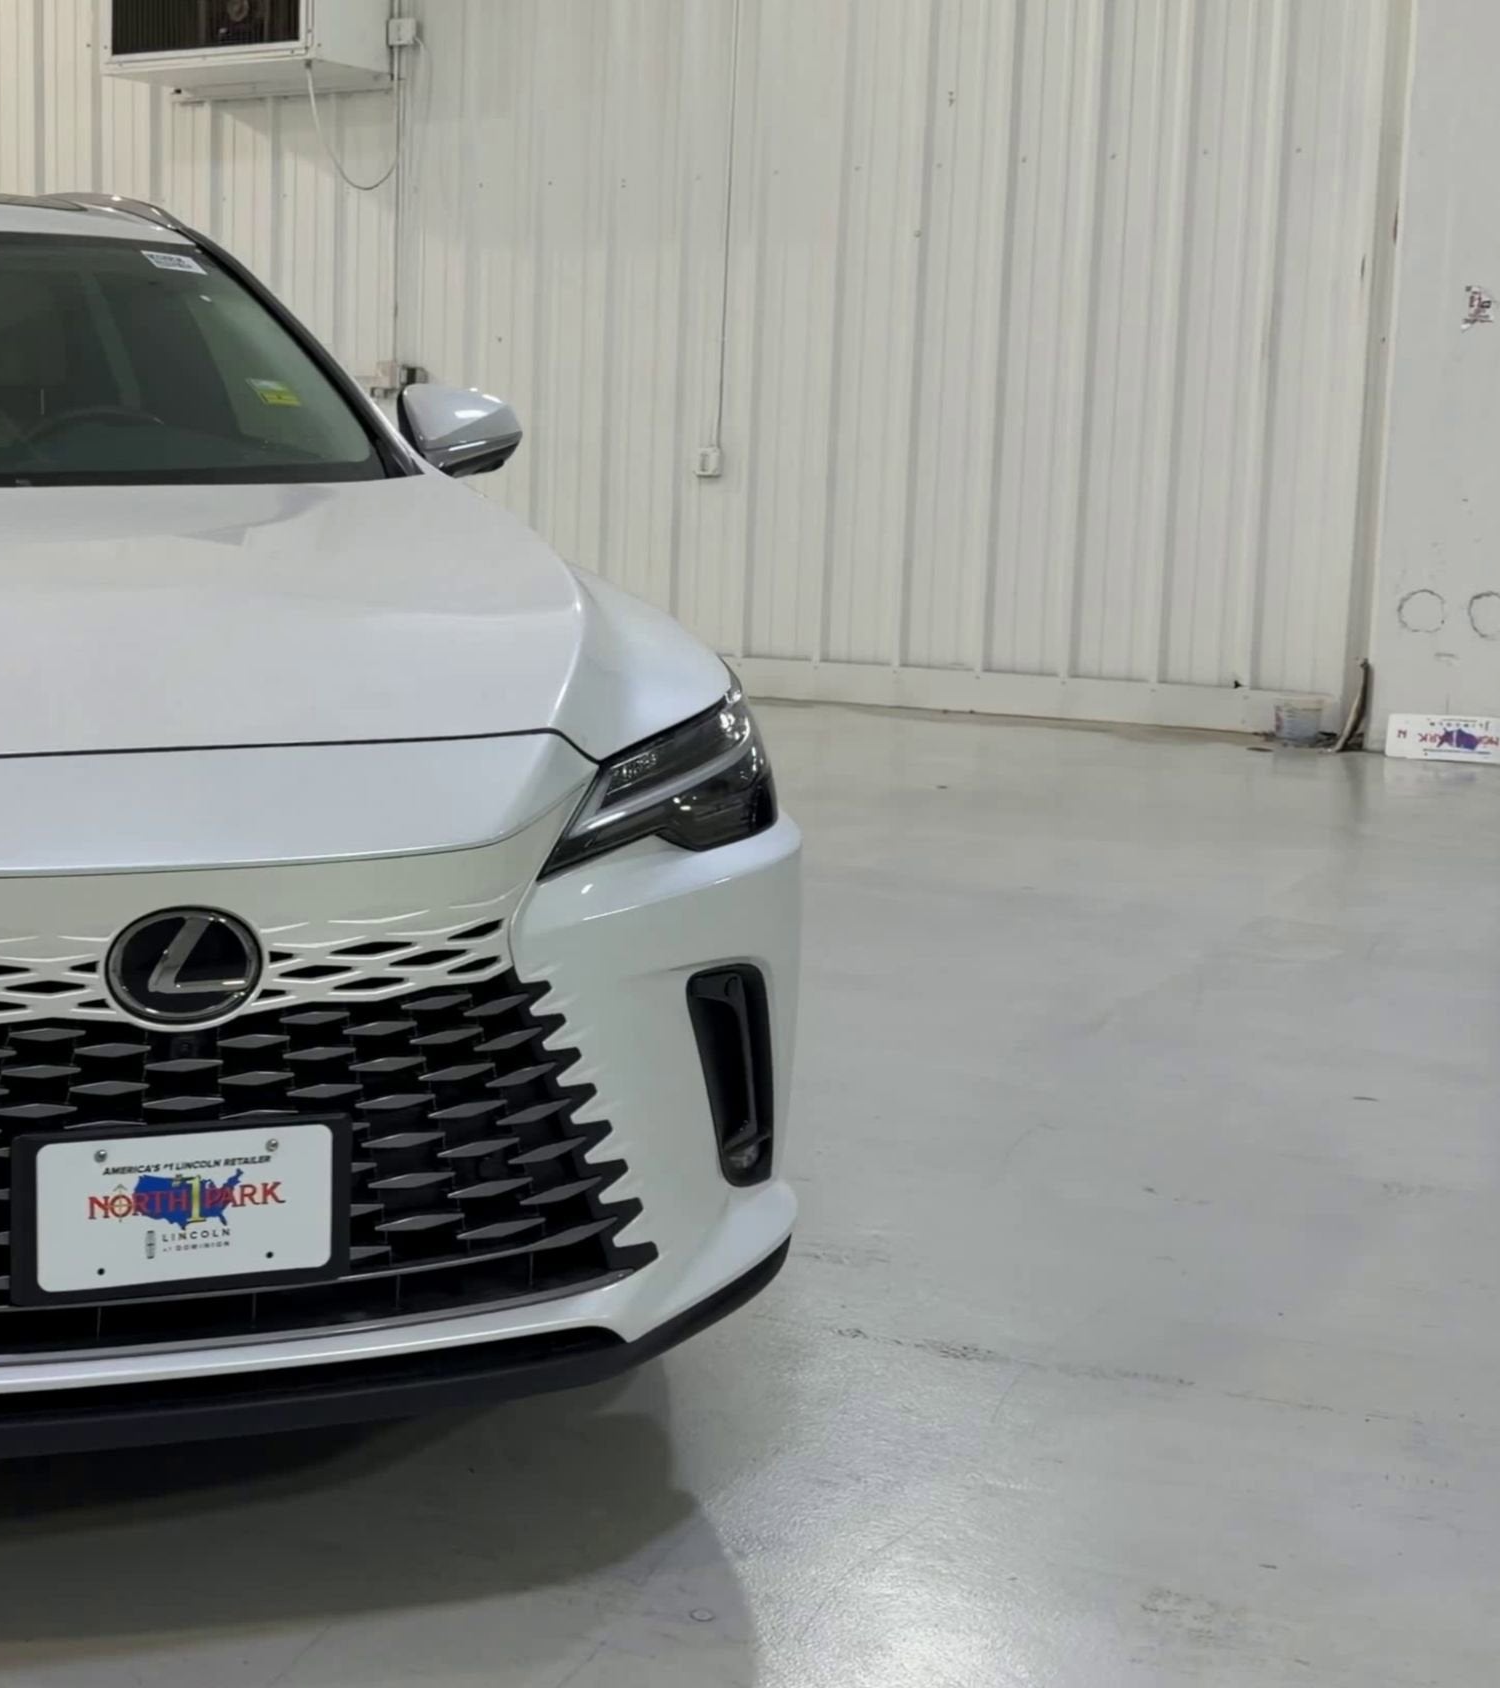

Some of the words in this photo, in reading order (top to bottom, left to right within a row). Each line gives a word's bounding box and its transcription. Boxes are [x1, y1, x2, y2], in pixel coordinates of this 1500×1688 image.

[103, 1163, 160, 1176] AMERICA'S
[176, 1157, 221, 1171] LINCOLN
[223, 1155, 272, 1167] RETAILER
[88, 1190, 191, 1219] NORTH
[203, 1181, 286, 1208] PARK
[161, 1228, 230, 1242] LINCOLN
[175, 1240, 230, 1252] DOMINION
